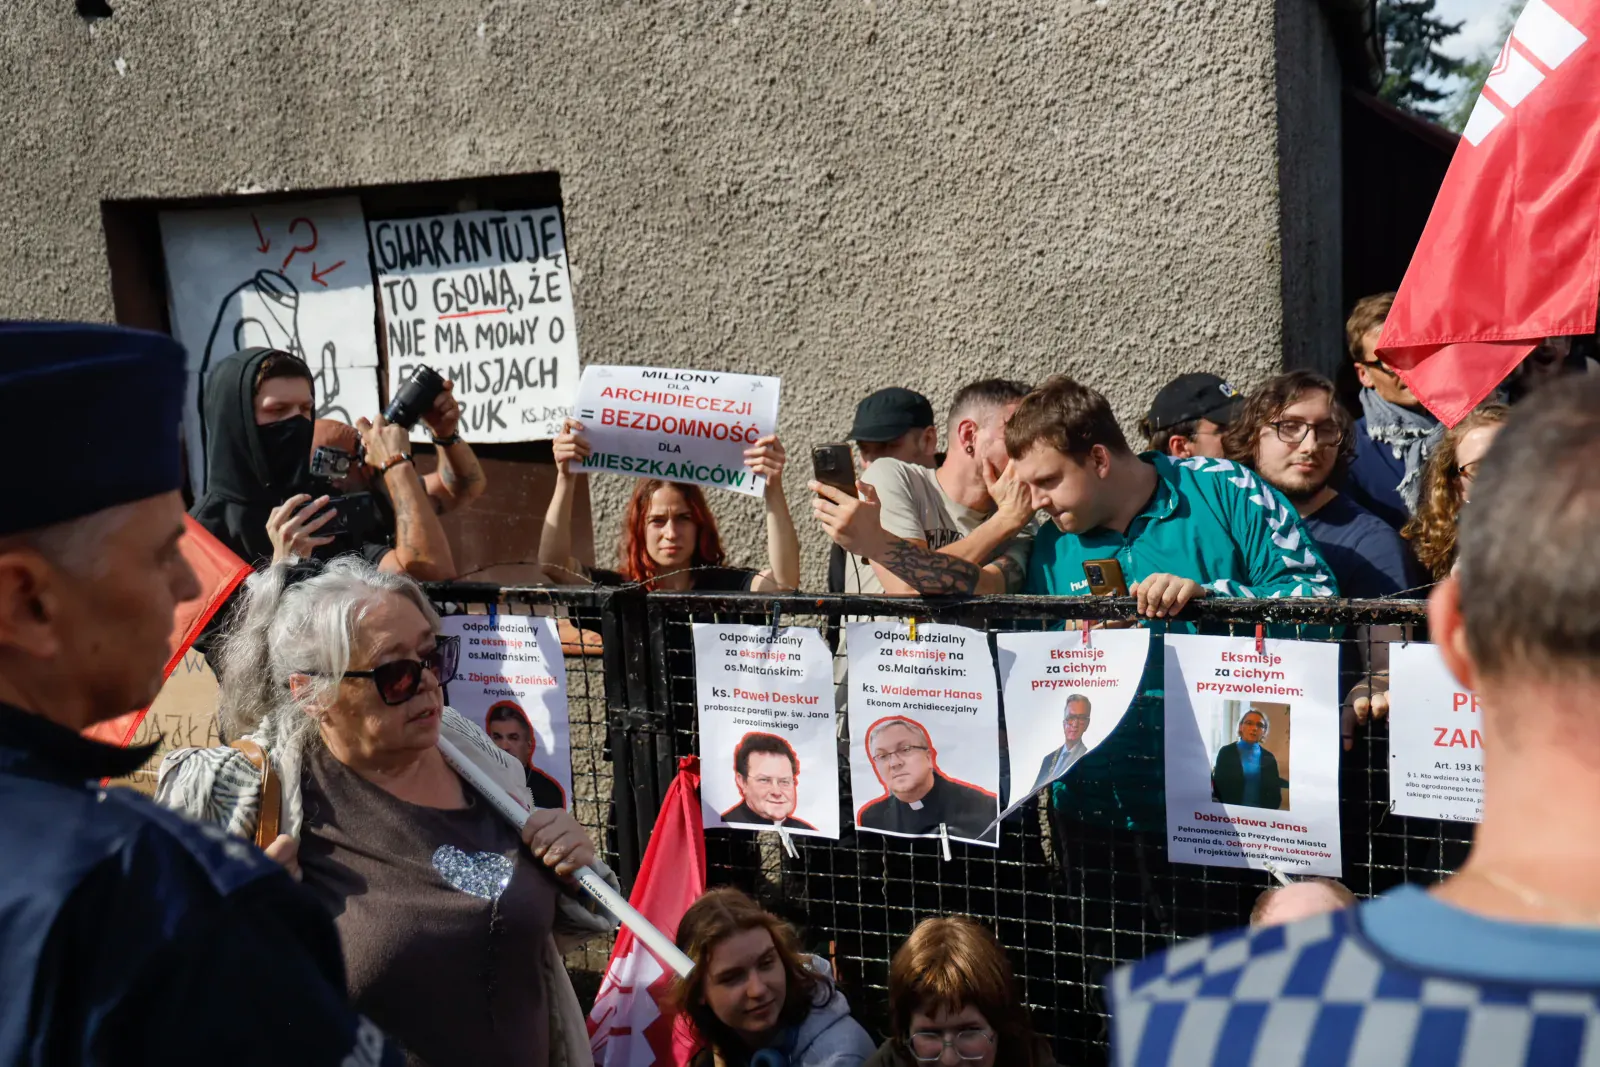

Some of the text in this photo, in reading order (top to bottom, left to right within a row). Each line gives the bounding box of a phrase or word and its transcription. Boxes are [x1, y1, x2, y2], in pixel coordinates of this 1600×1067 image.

[383, 278, 417, 315] TO
[529, 267, 562, 304] ŻE
[389, 316, 566, 357] NIE MA MOWY O
[641, 370, 720, 384] MILIONY
[667, 383, 690, 391] DLA
[600, 386, 752, 416] ARCHIDIECEZJI
[601, 407, 760, 445] BEZDOMNOŚĆ
[658, 442, 681, 454] DLA
[582, 452, 746, 487] MIESZKAŃCÓW
[462, 623, 539, 636] Odpowiedzialny
[481, 637, 523, 650] eksmisję
[524, 640, 537, 648] na
[719, 632, 804, 648] Odpowiedzialny
[725, 648, 801, 663] za eksmisję na
[880, 648, 964, 662] za eksmisję na
[1050, 647, 1104, 661] Eksmisje
[1221, 652, 1282, 667] Eksmisje
[1046, 663, 1107, 675] za cichym
[1215, 668, 1285, 682] za cichym
[468, 672, 513, 686] Zbigniew
[515, 675, 558, 686] Zieliński
[1031, 677, 1119, 690] przyzwoleniem:
[483, 688, 526, 698] Arcybiskup
[712, 686, 819, 705] ks. Paweł Deskur
[862, 683, 983, 700] ks. Waldemar Hanas
[1197, 681, 1304, 697] przyzwoleniem:
[704, 703, 829, 720] proboszcz parafii pw. św. Jana
[866, 699, 978, 715] Ekonom Archidiecezjalny
[732, 717, 799, 731] Jerozolimskiego
[1434, 761, 1452, 770] Art.
[1455, 763, 1472, 771] 193
[1406, 791, 1431, 799] takiego
[1421, 783, 1464, 792] ogrodzonego
[1194, 811, 1308, 833] Dobrosława Janas
[1178, 825, 1327, 848] Pełnomocniczka Prezydenta Miasta
[1173, 835, 1332, 858] Poznania ds. Ochrony Praw Lokatorów
[1198, 847, 1239, 858] Projektów
[1241, 851, 1311, 866] Mieszkaniowych
